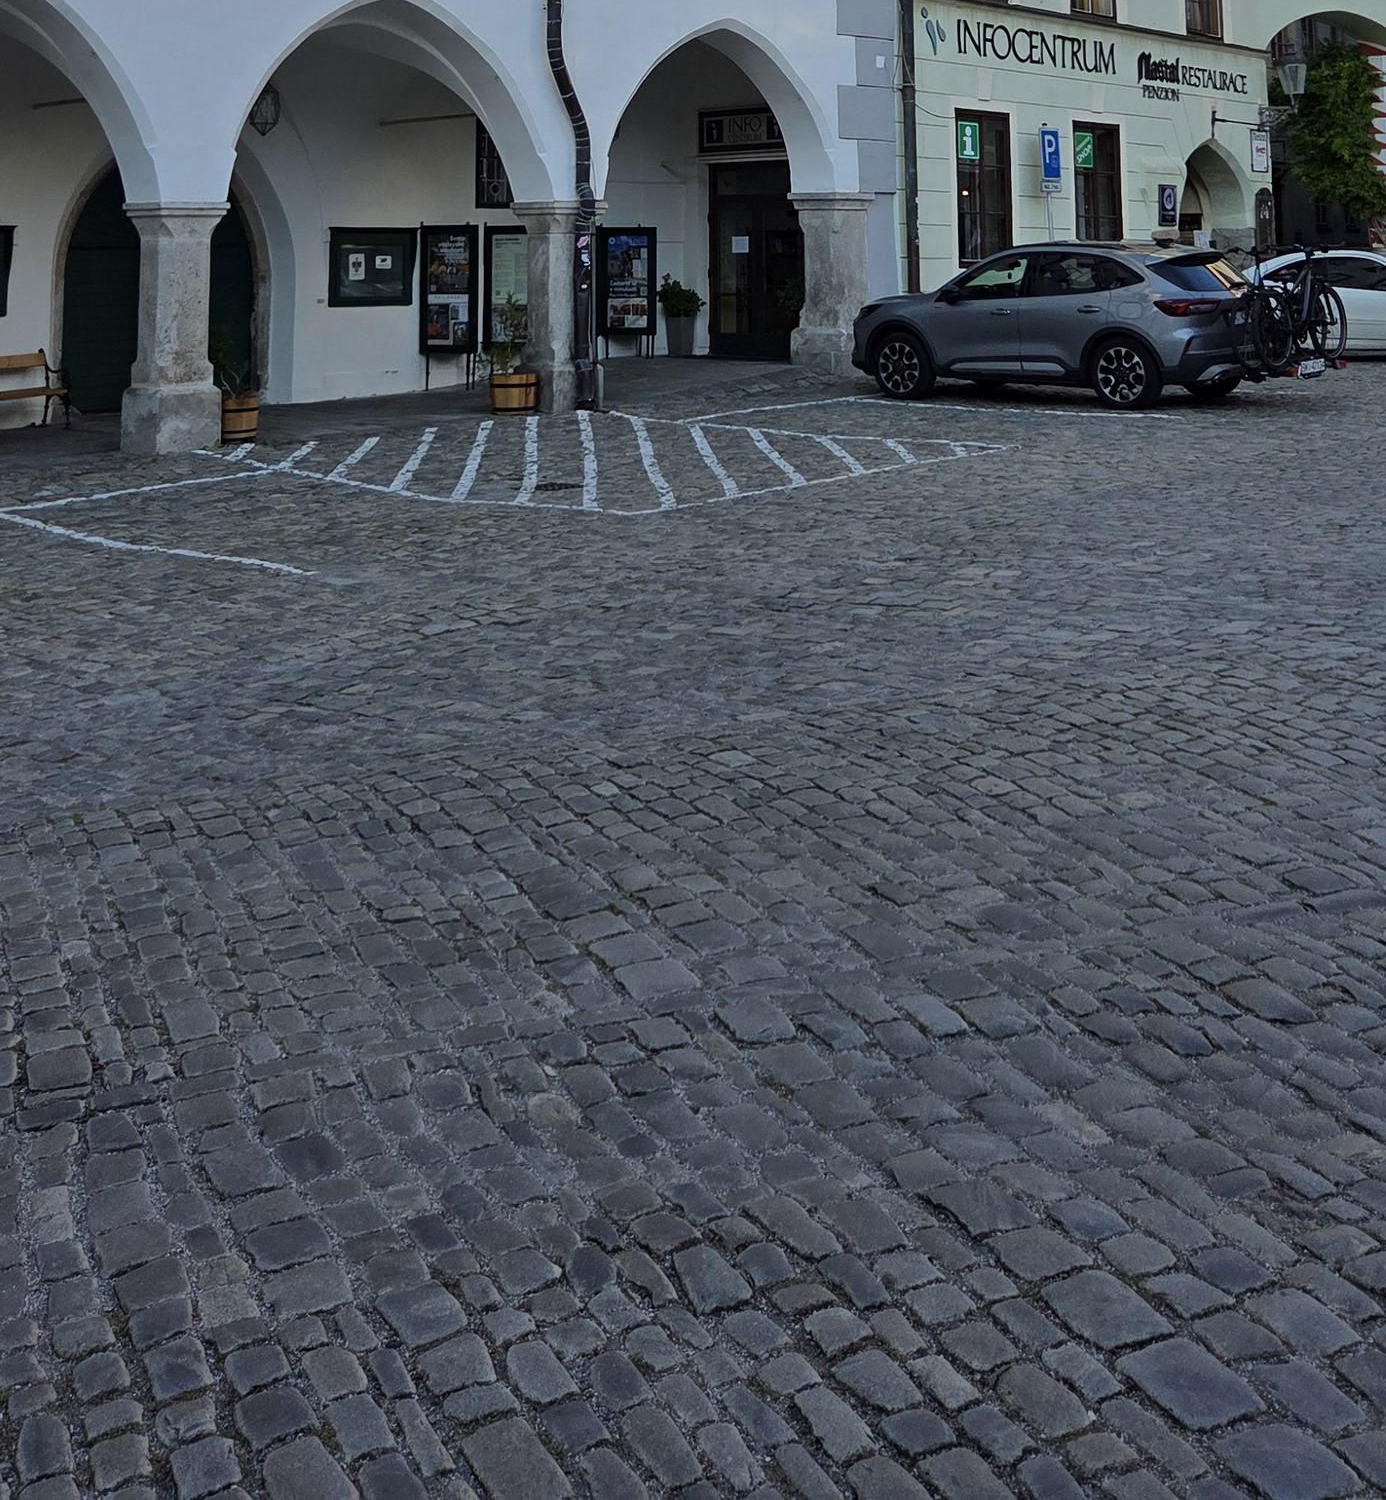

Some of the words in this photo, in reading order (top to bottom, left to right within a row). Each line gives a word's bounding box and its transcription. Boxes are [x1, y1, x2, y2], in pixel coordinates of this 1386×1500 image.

[956, 18, 1117, 75] INFOCENTRUM
[1142, 84, 1180, 102] PENZION
[1181, 65, 1248, 95] RESTAURACE
[728, 115, 762, 133] INFO
[1044, 134, 1056, 164] P
